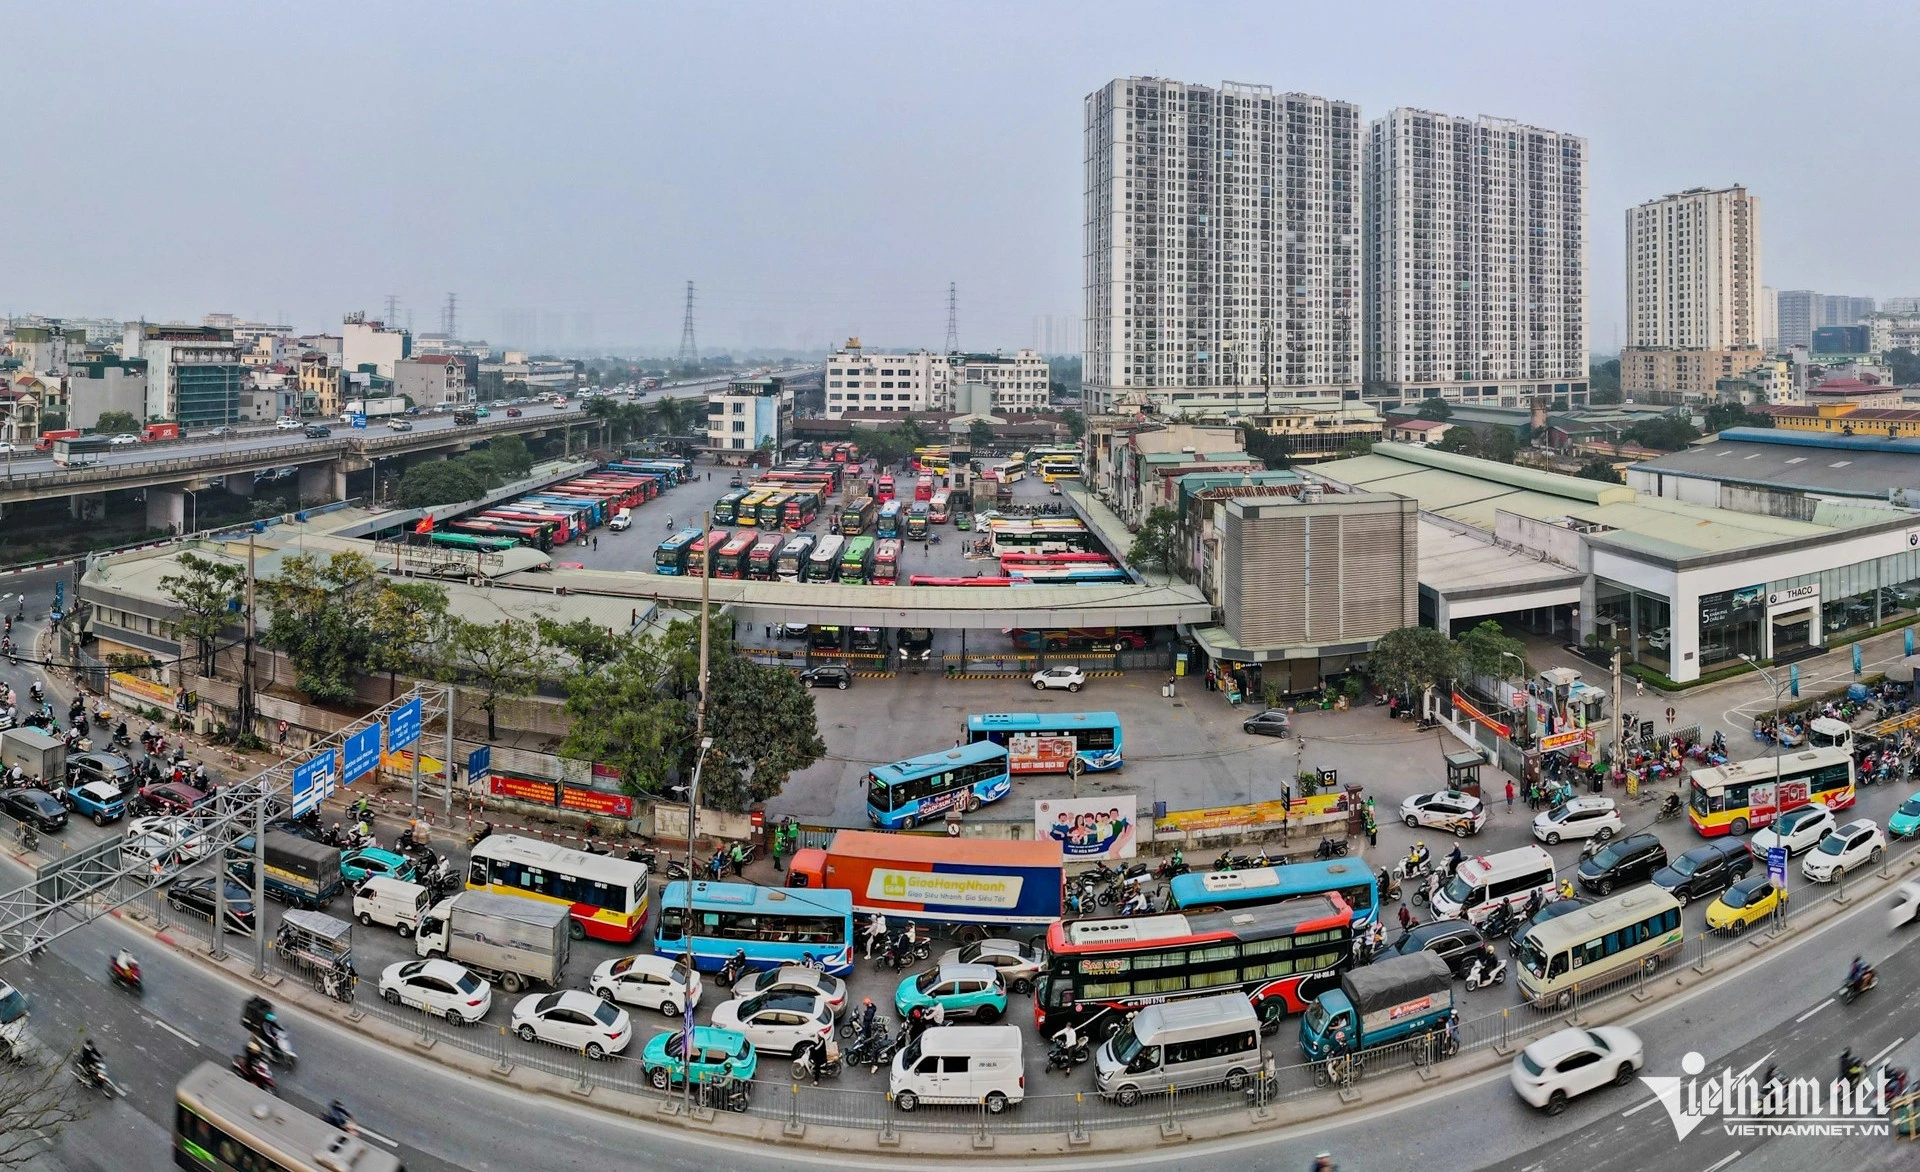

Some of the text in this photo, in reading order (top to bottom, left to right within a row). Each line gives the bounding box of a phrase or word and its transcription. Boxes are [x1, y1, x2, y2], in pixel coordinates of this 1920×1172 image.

[1787, 585, 1813, 598] THACO
[1702, 609, 1710, 624] 5
[1324, 771, 1335, 781] C1
[908, 876, 1006, 894] GiaoHangNhanh
[1088, 967, 1121, 976] TRAVEL
